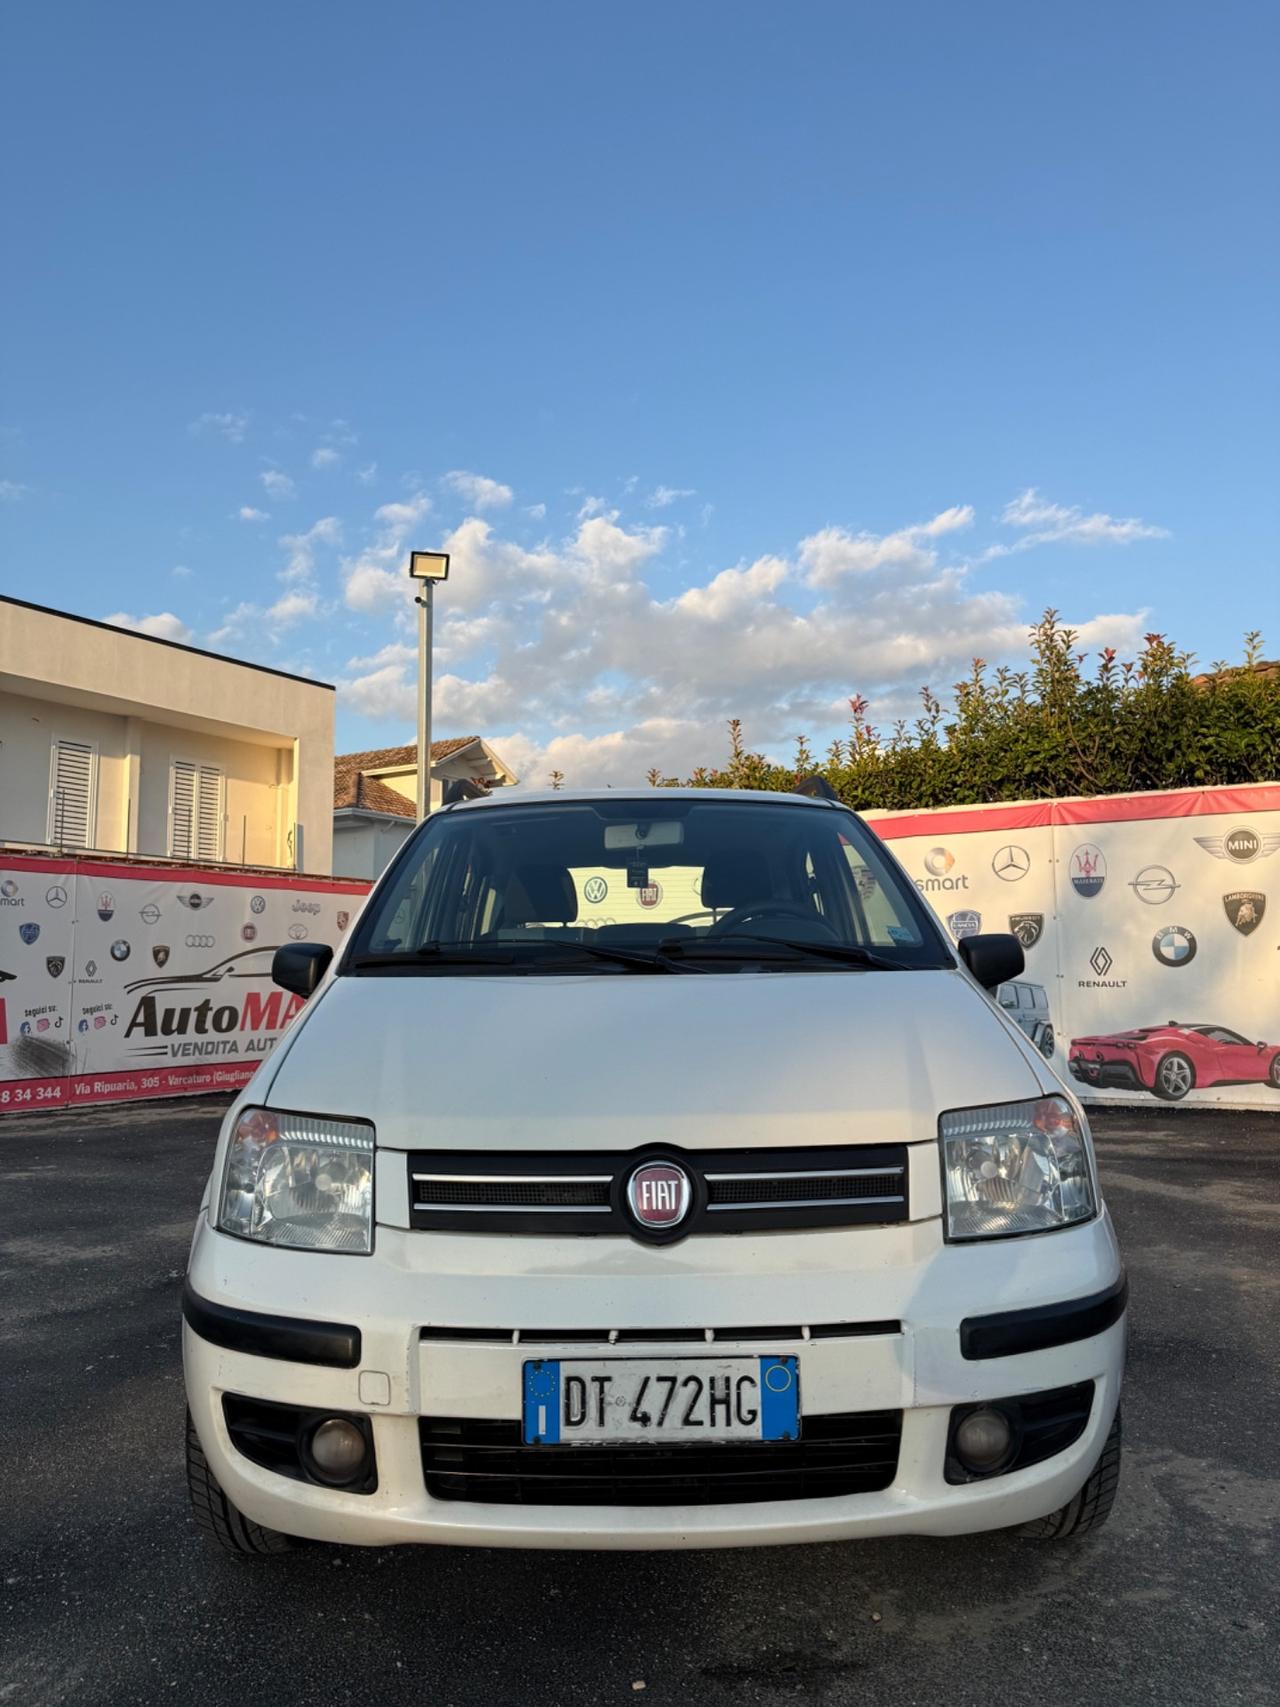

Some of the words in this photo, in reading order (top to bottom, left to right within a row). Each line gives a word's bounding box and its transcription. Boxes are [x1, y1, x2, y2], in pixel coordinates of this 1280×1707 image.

[1228, 839, 1258, 850] MINI
[914, 875, 969, 891] smart
[1078, 980, 1127, 988] RENAULT
[170, 1040, 239, 1057] VENDITA
[74, 1083, 91, 1095] Via
[94, 1079, 138, 1094] Ripuaria,
[141, 1077, 160, 1088] 305
[167, 1074, 211, 1086] Varcaturo
[1, 1090, 11, 1103] 8
[14, 1088, 32, 1102] 34
[36, 1086, 61, 1100] 344
[642, 1181, 678, 1210] FIAT
